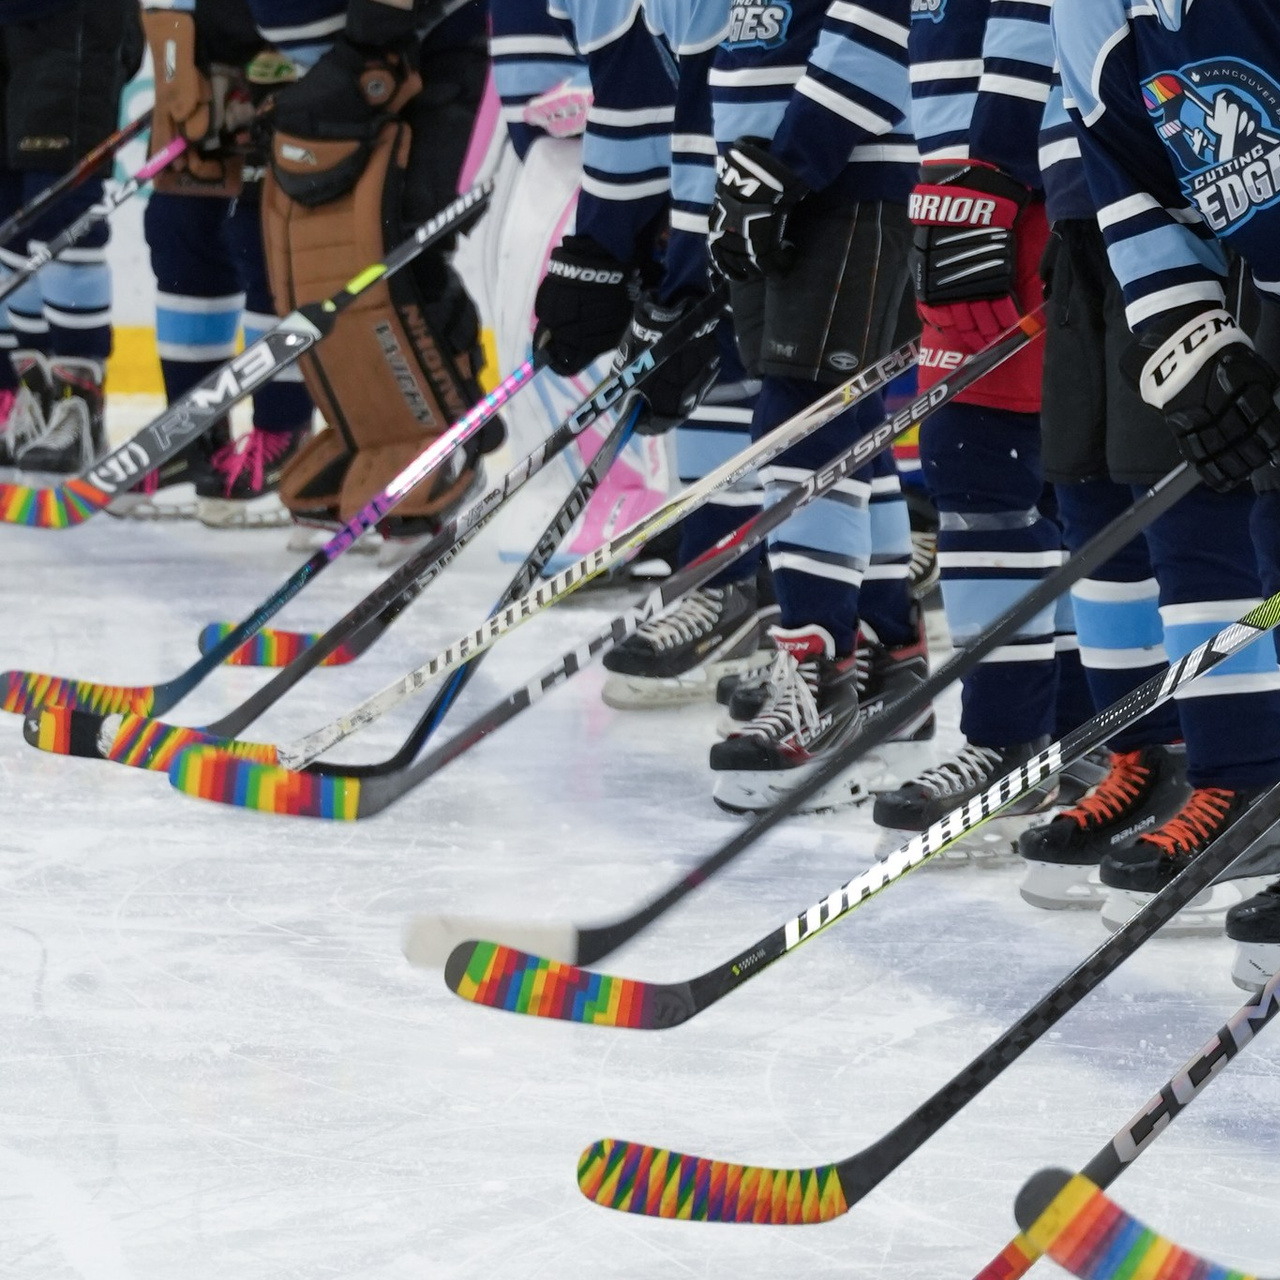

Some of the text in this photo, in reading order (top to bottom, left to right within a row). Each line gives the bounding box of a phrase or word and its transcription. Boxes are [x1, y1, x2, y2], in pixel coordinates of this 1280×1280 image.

[729, 6, 785, 42] GES
[1204, 69, 1276, 105] VANCOUVER
[1194, 143, 1265, 190] CUTTING
[908, 193, 997, 226] RRIOR
[1150, 316, 1237, 387] CCM
[568, 349, 656, 433] CCM
[799, 383, 949, 505] JETSPEED
[483, 488, 501, 504] PRO
[777, 640, 810, 654] CCM
[785, 740, 1062, 953] WARRIOR
[1110, 815, 1156, 846] BAUER
